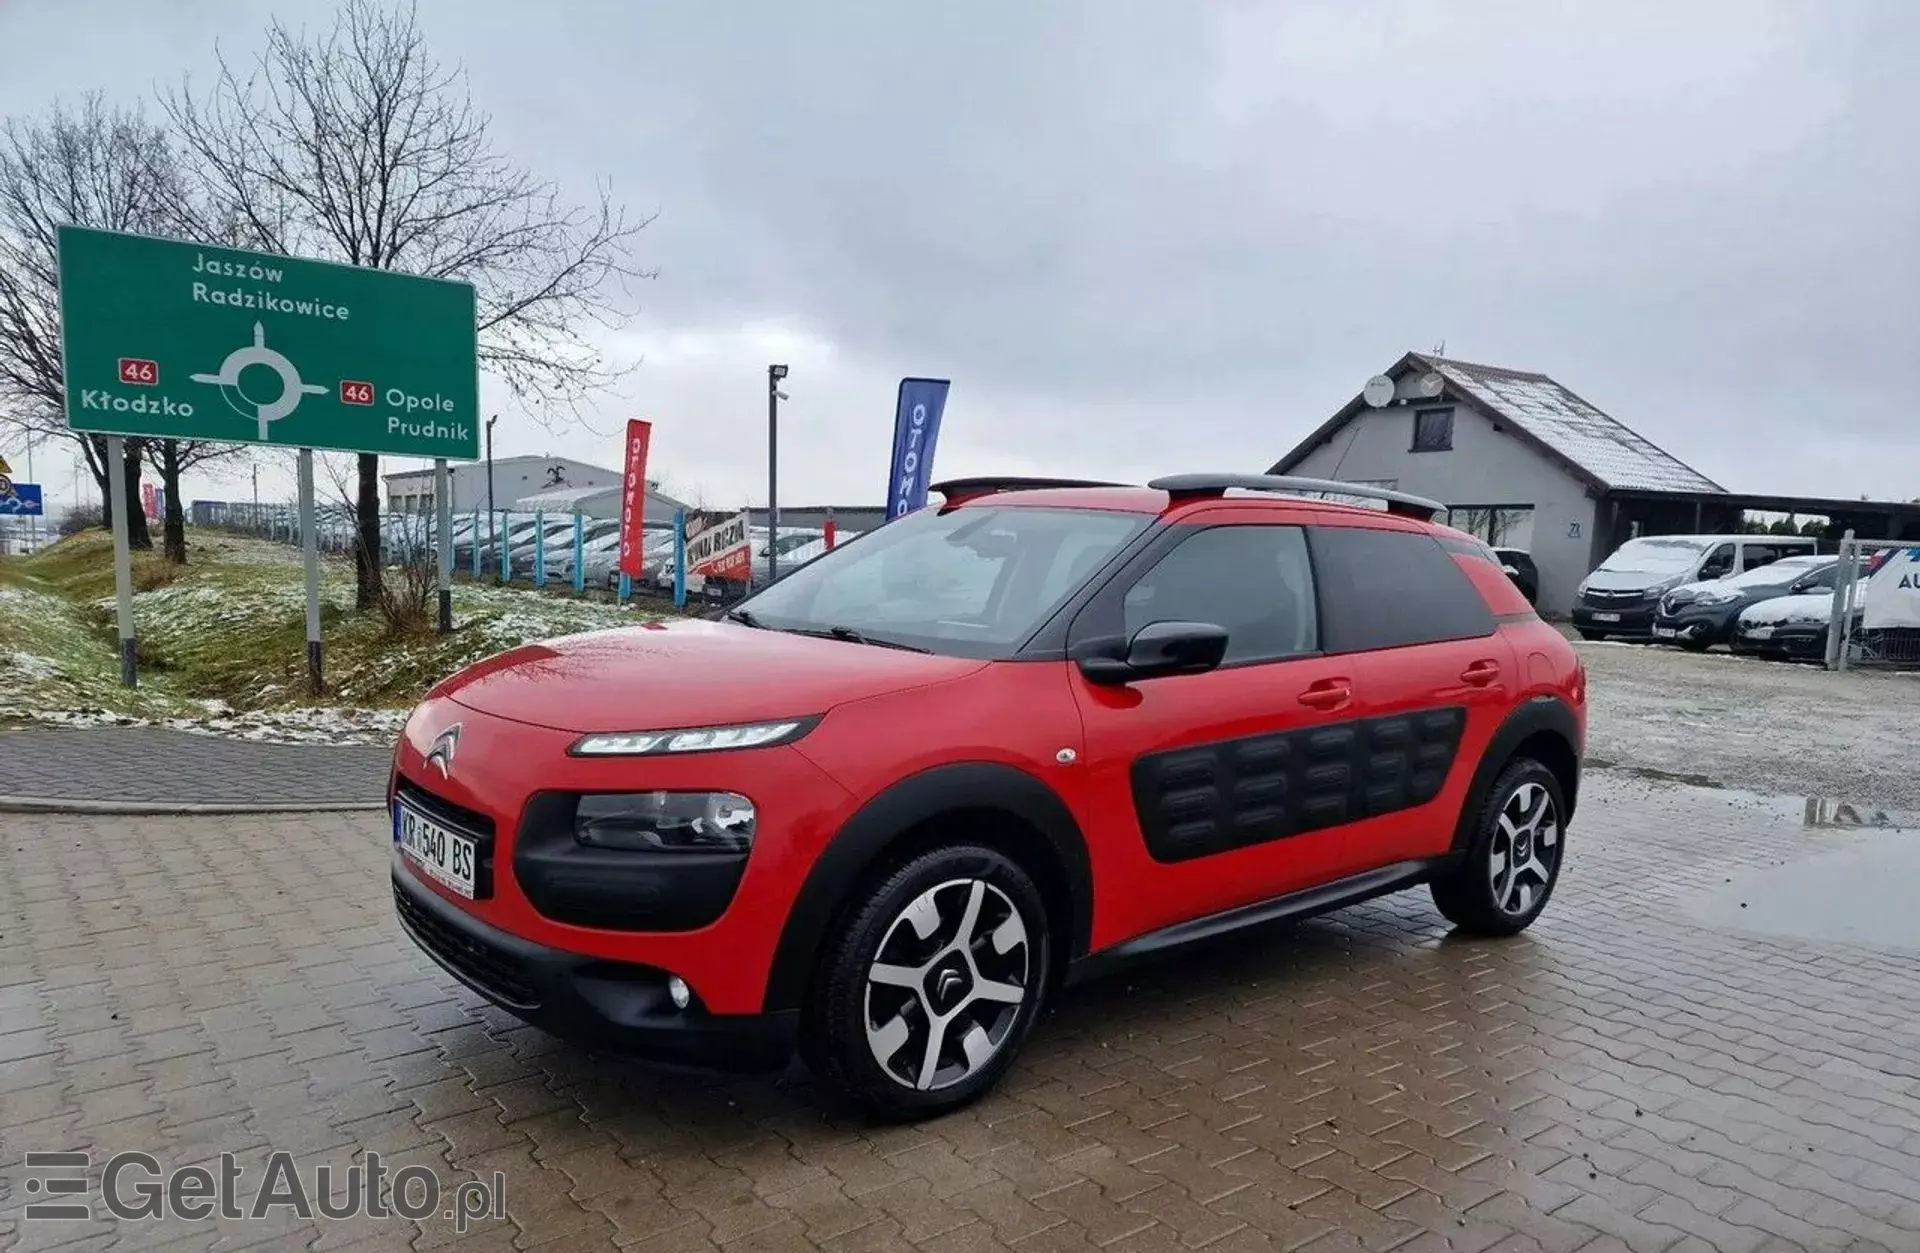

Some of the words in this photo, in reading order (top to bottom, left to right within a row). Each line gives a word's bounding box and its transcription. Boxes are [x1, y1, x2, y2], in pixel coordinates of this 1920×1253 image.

[192, 252, 283, 283] Jaszów
[192, 281, 349, 320] Radzikowice
[124, 363, 153, 381] 46
[81, 389, 194, 417] Kłodzko
[346, 385, 369, 401] 46
[385, 388, 455, 413] Opole
[387, 416, 468, 441] Prudnik
[422, 822, 446, 868] 540
[452, 838, 472, 881] BS
